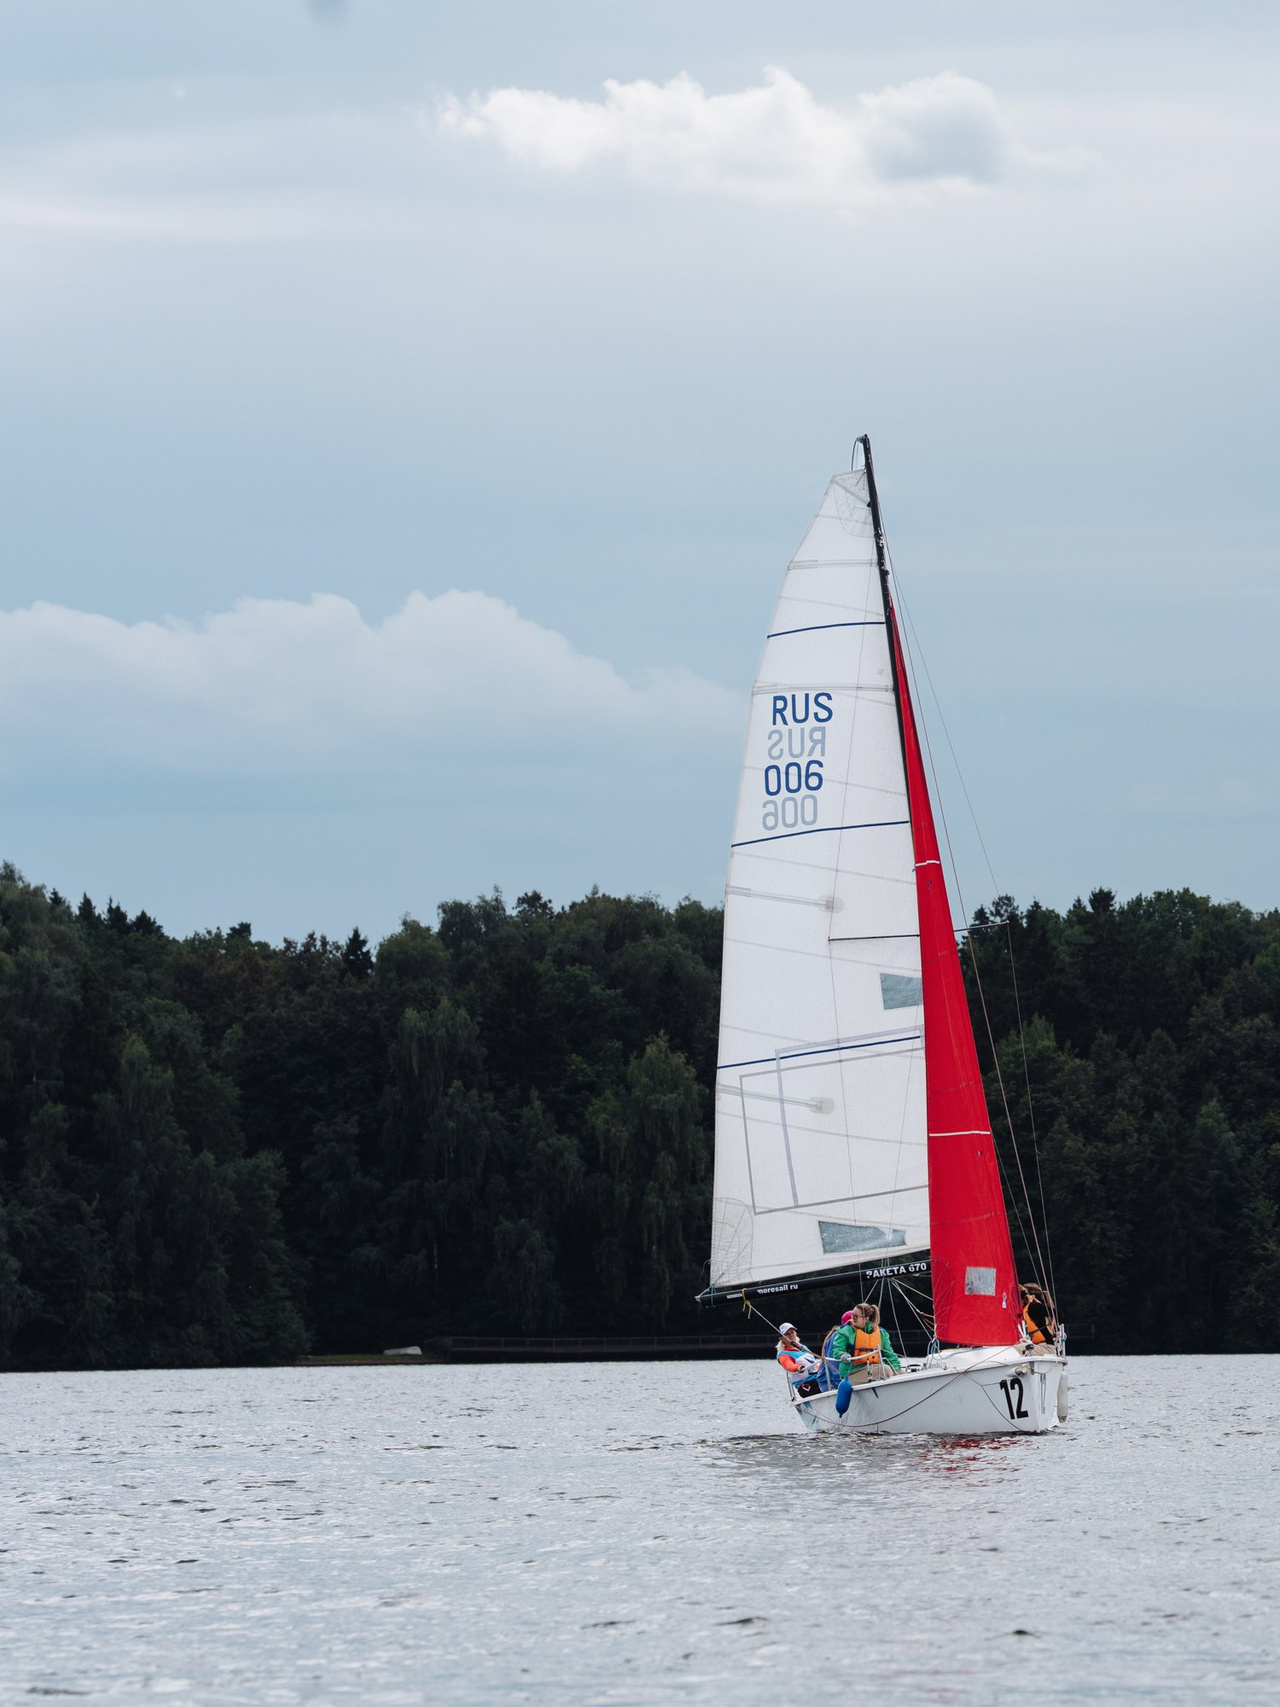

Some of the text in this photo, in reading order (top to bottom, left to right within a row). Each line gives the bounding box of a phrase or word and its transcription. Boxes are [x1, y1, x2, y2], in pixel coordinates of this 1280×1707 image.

[772, 692, 833, 726] RUS
[764, 759, 824, 797] 006
[908, 1262, 927, 1273] 670
[999, 1377, 1029, 1420] 12
